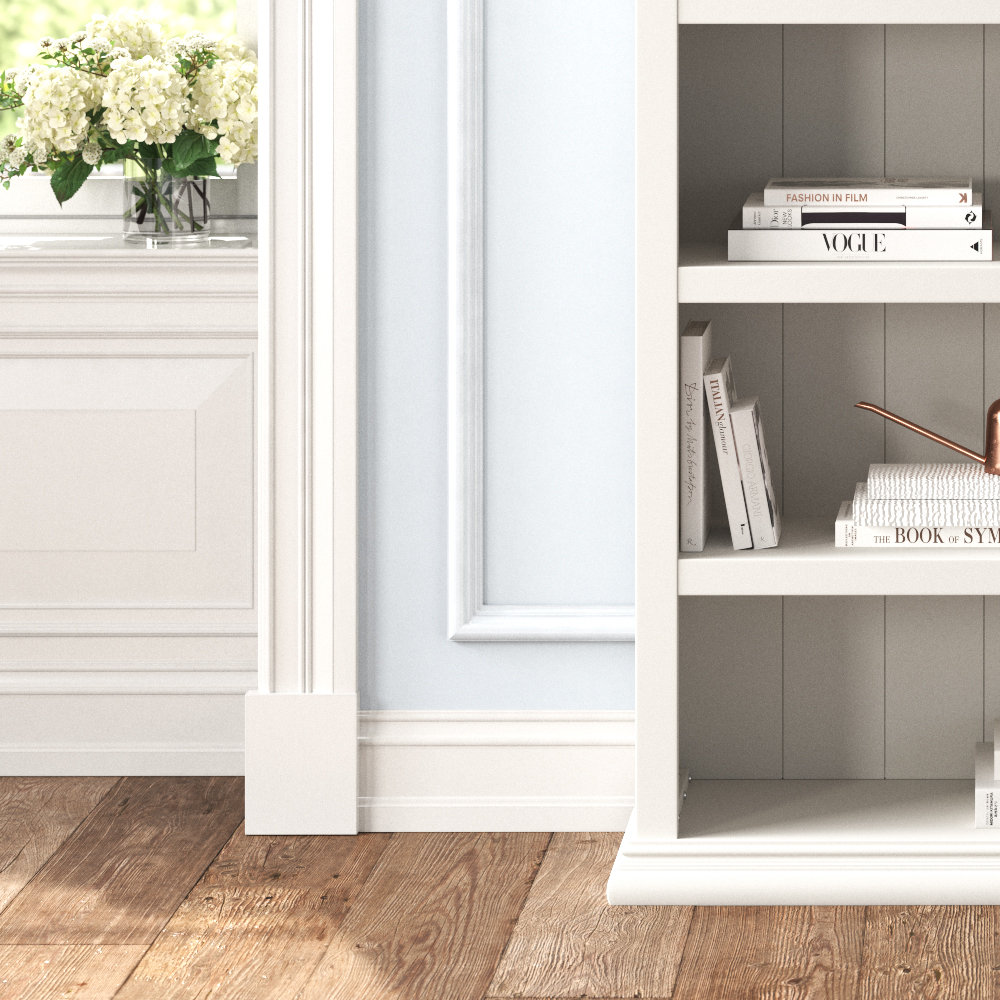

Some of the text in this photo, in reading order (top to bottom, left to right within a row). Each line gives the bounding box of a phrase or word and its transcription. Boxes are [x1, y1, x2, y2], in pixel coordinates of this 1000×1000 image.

[786, 193, 868, 203] FASHION IN FILM
[770, 208, 779, 228] Dior
[822, 233, 887, 252] VOGUE
[710, 379, 729, 455] ITALIAN glamour
[748, 480, 762, 519] ARMANI
[873, 535, 891, 544] THE
[895, 527, 944, 544] BOOK
[948, 535, 960, 544] OF
